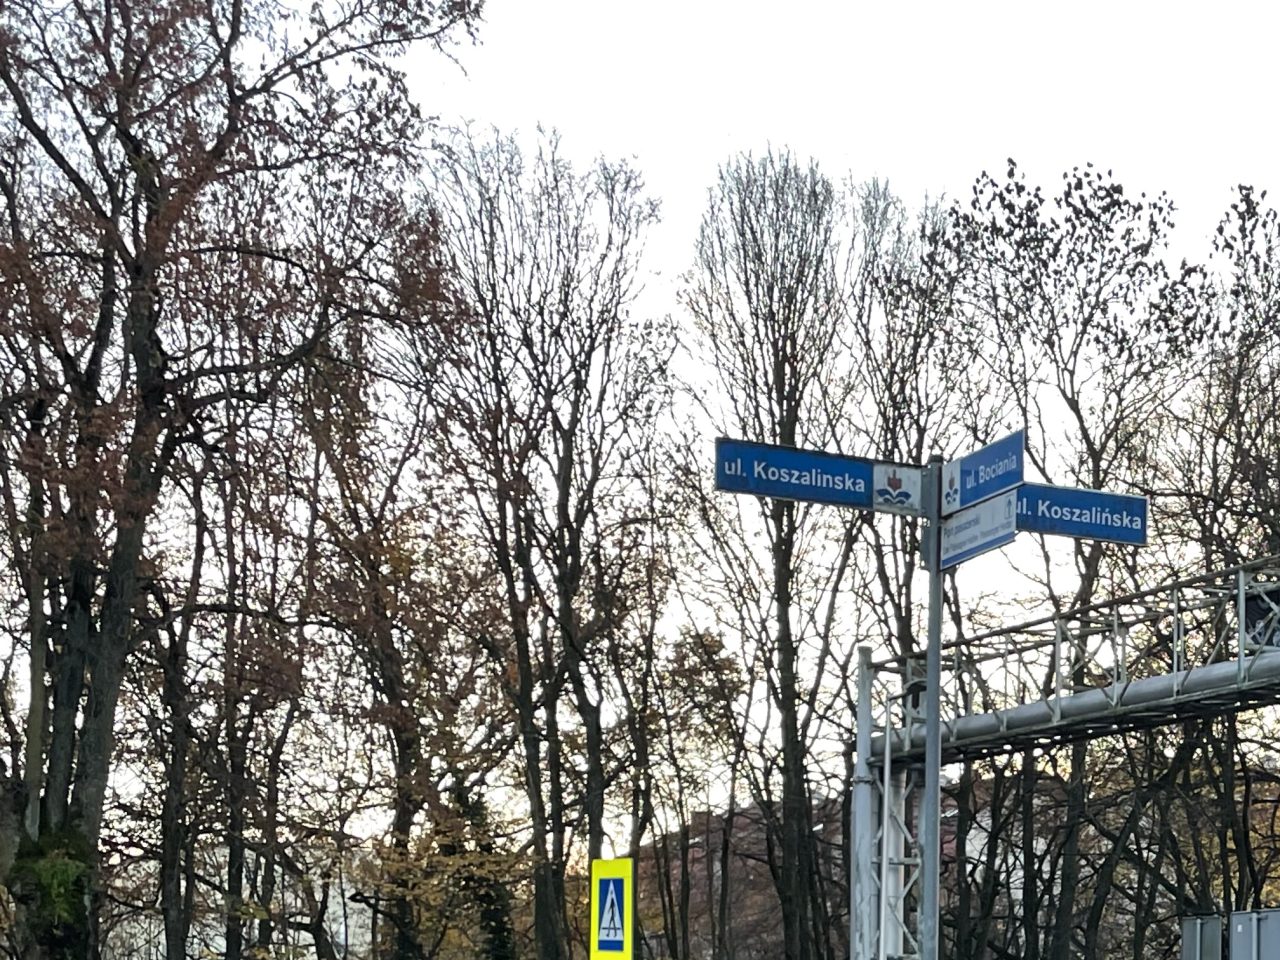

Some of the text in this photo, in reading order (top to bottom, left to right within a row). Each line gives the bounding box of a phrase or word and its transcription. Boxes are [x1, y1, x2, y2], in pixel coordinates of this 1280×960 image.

[724, 458, 747, 477] ul.
[966, 451, 1017, 489] ul. Bociania
[1037, 499, 1142, 530] Koszalińska
